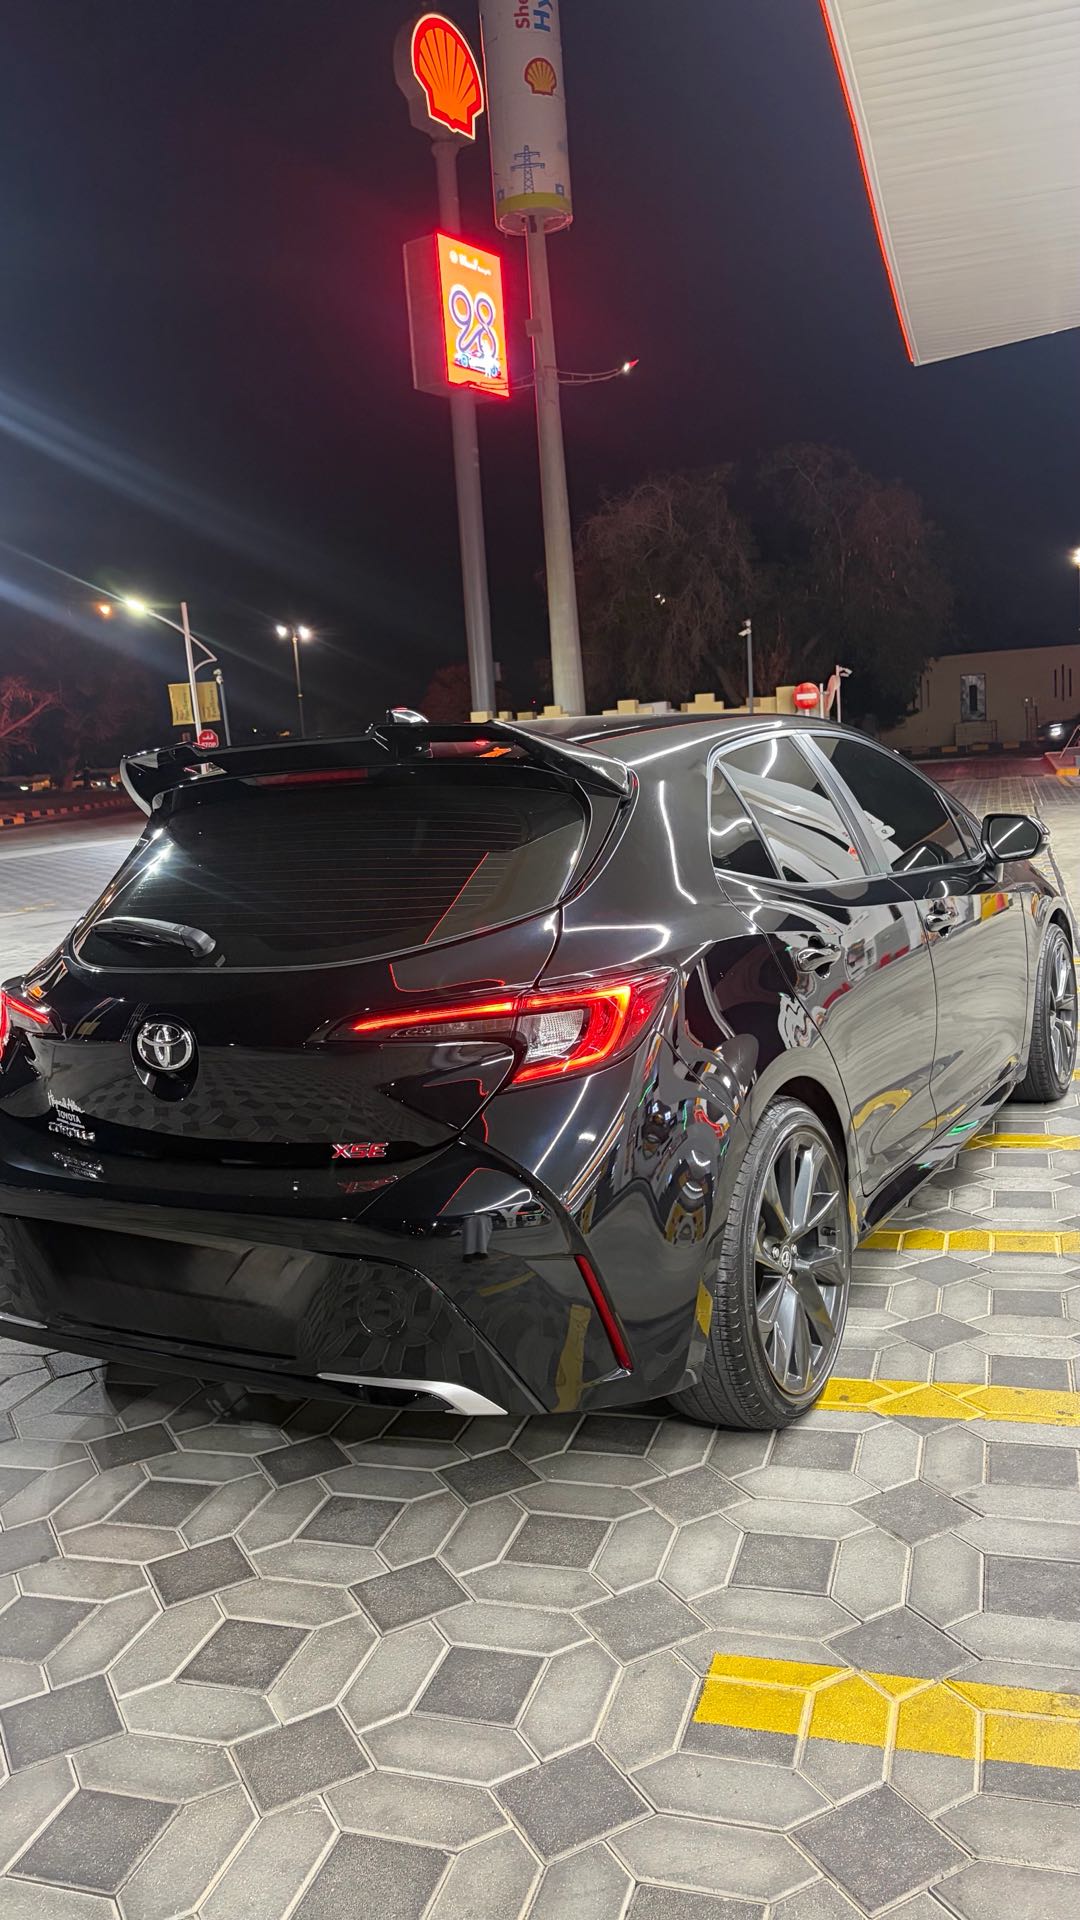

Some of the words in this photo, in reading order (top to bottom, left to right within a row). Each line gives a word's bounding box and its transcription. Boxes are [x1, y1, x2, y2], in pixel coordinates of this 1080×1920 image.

[449, 284, 498, 358] 98
[57, 1110, 81, 1124] TOYOTA
[331, 1142, 389, 1159] XSE
